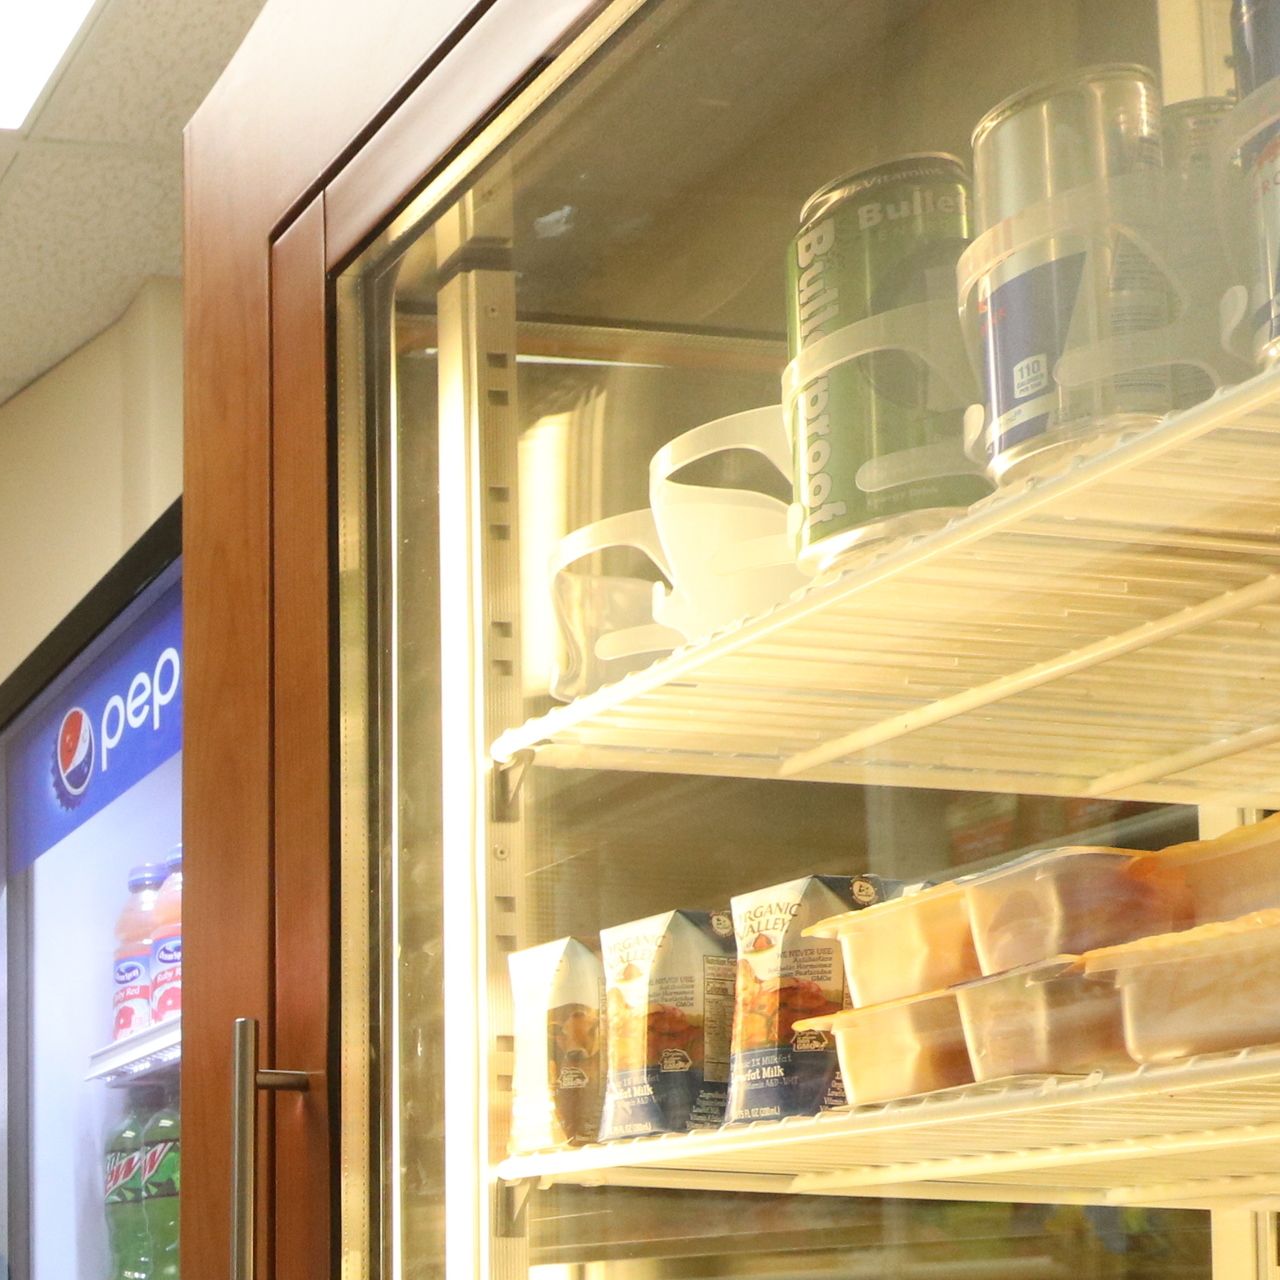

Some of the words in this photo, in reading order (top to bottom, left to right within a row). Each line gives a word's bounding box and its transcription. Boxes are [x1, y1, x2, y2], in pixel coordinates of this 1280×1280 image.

[1018, 359, 1040, 379] 110
[100, 647, 181, 772] pep
[762, 1067, 785, 1079] Milk
